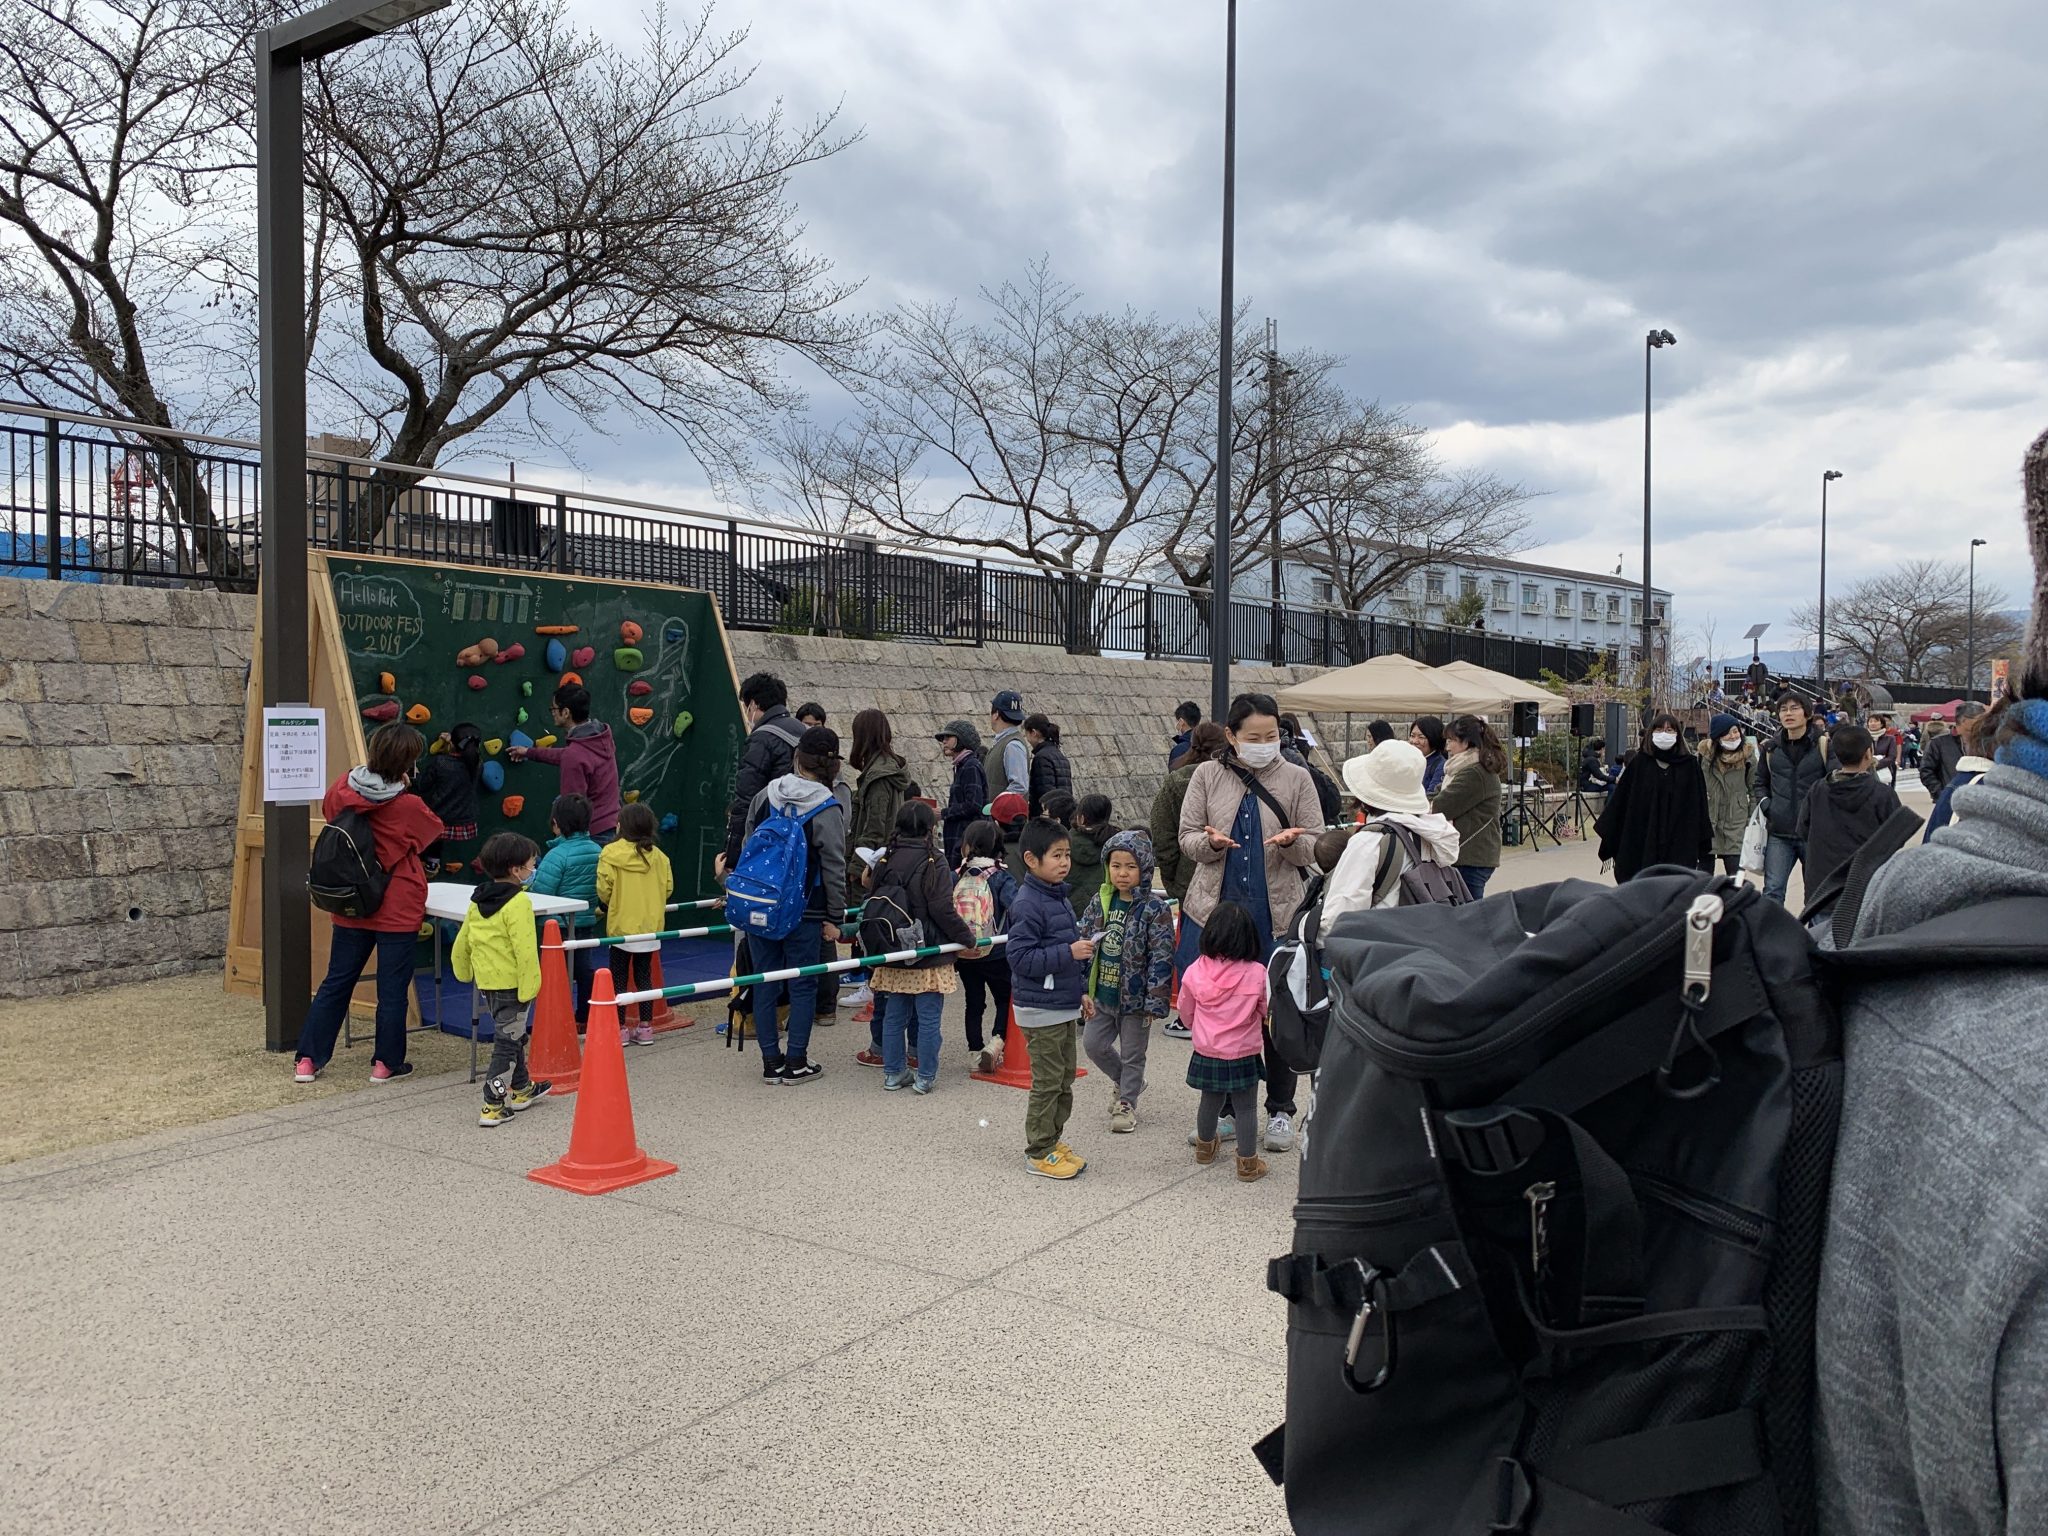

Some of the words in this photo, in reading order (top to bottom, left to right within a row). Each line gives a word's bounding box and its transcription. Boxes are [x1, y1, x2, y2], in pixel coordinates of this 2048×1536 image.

[340, 580, 376, 606] Hello
[378, 586, 399, 608] Park
[441, 578, 453, 615] やさしめ
[338, 613, 393, 633] OUTDOOR
[363, 633, 401, 655] 2019
